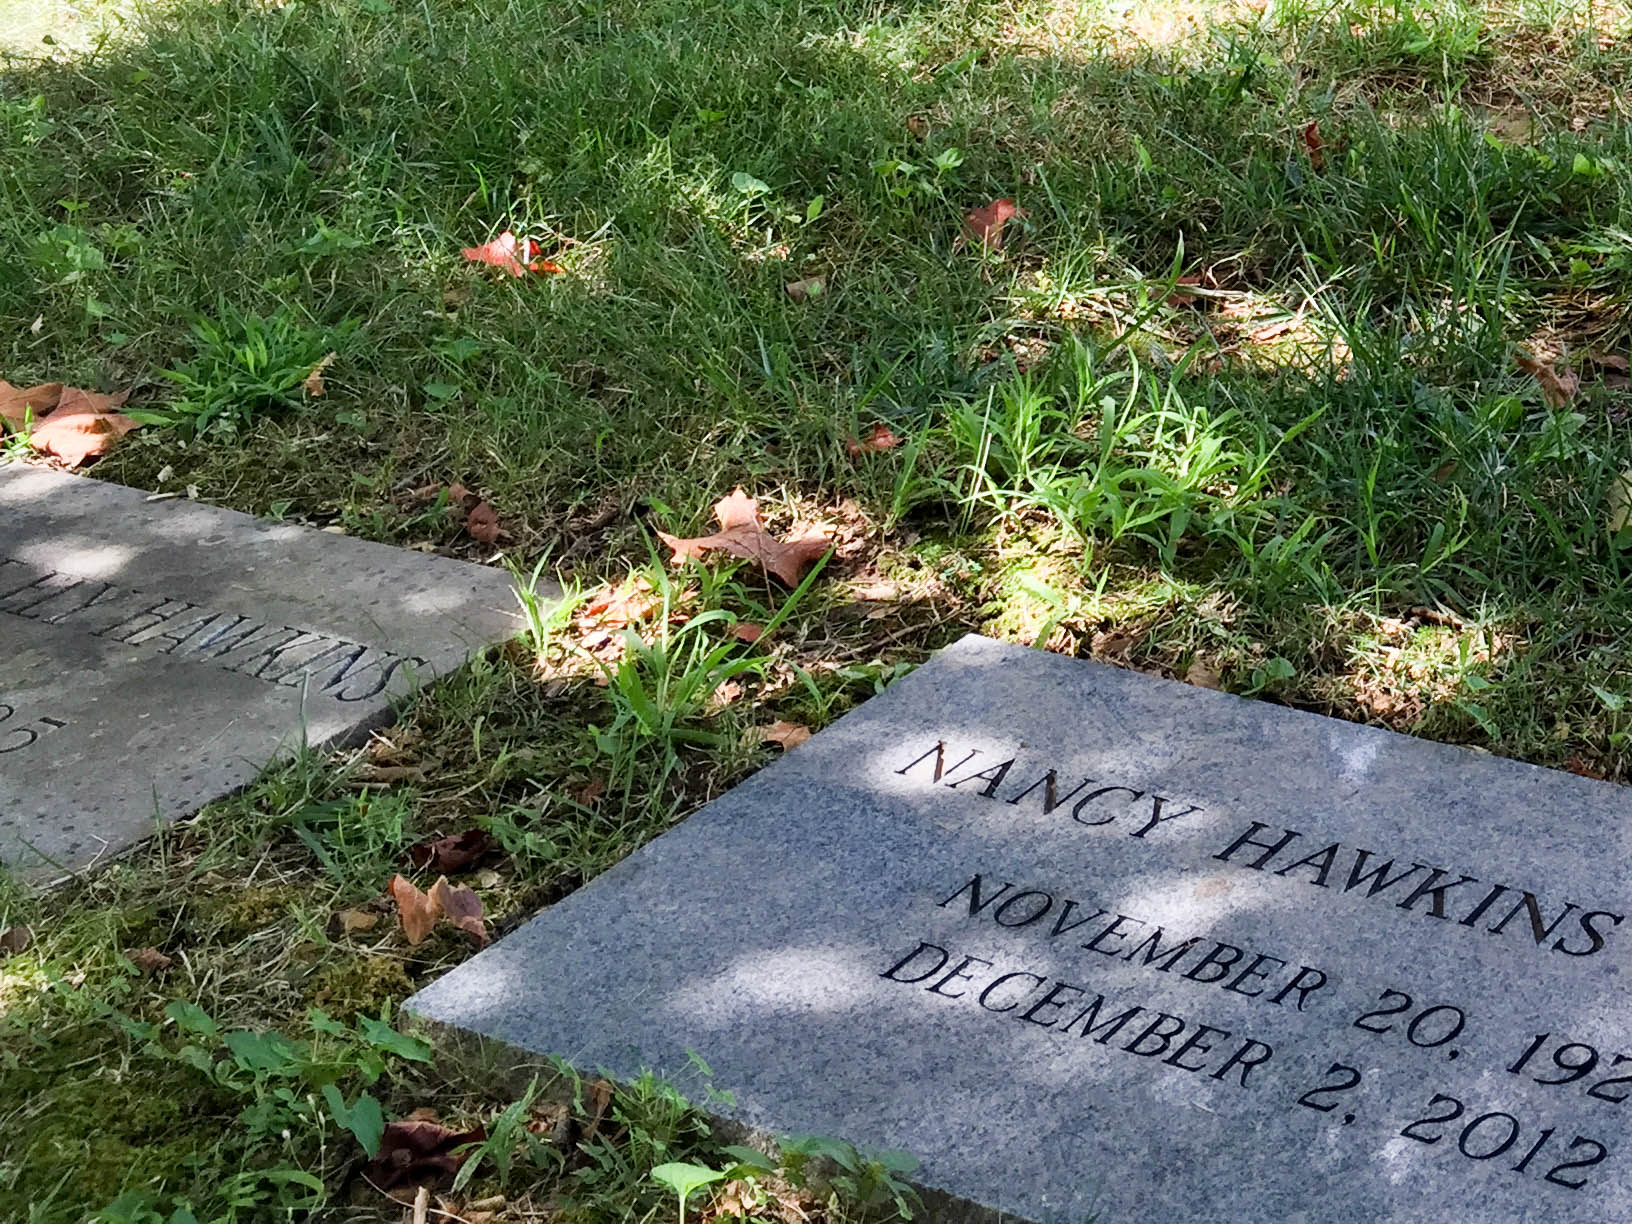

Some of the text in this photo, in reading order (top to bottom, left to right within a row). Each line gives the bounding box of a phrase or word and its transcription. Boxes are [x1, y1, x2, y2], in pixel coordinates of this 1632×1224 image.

[90, 597, 432, 702] HAWKINS
[895, 739, 1205, 838] NANCY
[1213, 821, 1624, 957] HAWKINS
[937, 873, 1327, 1011] NOVEMBER
[879, 942, 1274, 1088] DECEMBER
[1401, 1093, 1609, 1190] 2012
